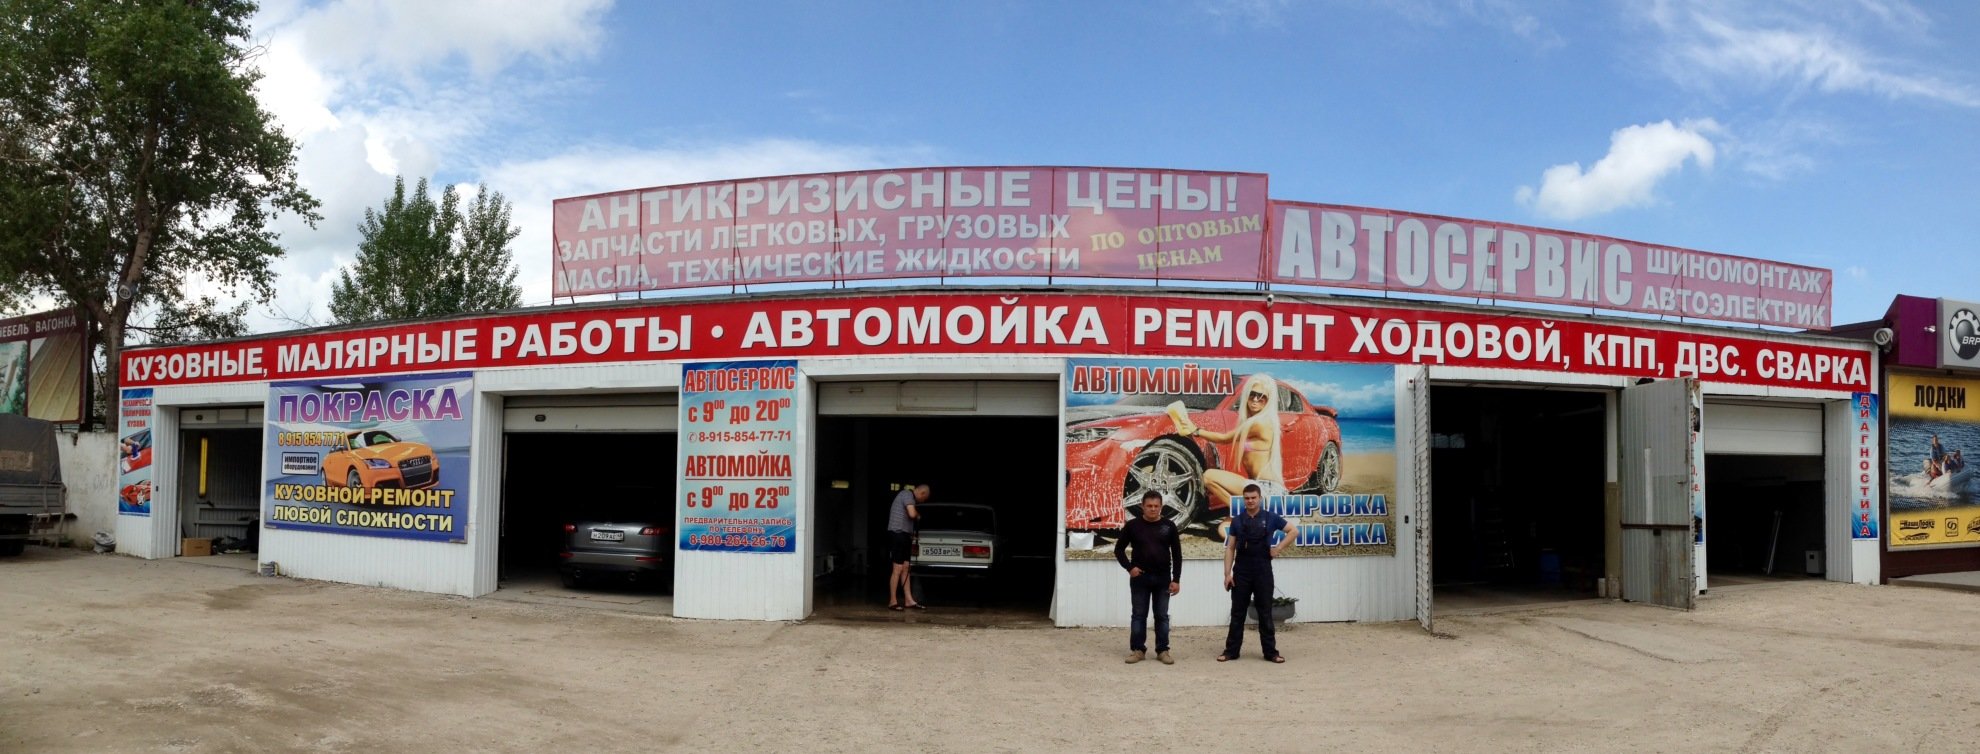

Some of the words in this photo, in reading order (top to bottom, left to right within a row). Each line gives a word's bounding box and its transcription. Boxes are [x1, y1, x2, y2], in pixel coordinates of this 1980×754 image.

[577, 171, 1031, 233] АНТИКРИЗИСНЫЕ
[1066, 171, 1238, 215] ЦЕНЫ!
[557, 226, 702, 262] ЗАПЧАСТИ
[710, 216, 886, 250] ЛЕГКОВЫХ,
[898, 213, 1070, 241] ГРУЗОВЫХ
[1090, 229, 1125, 253] ПО
[1137, 213, 1262, 246] ОПТОВЫМ
[557, 263, 659, 292] МАСЛА,
[667, 249, 885, 284] ТЕХНИЧЕСКИЕ
[895, 246, 1080, 276] ЖИДКОСТИ
[1136, 245, 1224, 271] ЦЕНАМ
[1277, 208, 1633, 307] АВТОСЕРВИС
[1646, 247, 1824, 294] ШИНОМОНТАЖ
[1641, 285, 1826, 328] АВТОЭЛЕКТРИК
[0, 323, 29, 338] ЕБЕЛЬ
[35, 315, 77, 333] ВАГОНКА
[1962, 335, 1980, 346] BRP
[126, 347, 268, 382] КУЗОВНЫЕ,
[277, 327, 478, 373] МАЛЯРНЫЕ
[491, 314, 692, 360] РАБОТЫ
[740, 296, 1110, 349] АВТОМОЙКА
[1133, 306, 1336, 352] РЕМОНТ
[1348, 316, 1571, 371] ХОДОВОЙ,
[1583, 332, 1665, 377] КПП,
[1674, 341, 1747, 379] ДВС.
[1756, 349, 1868, 386] СВАРКА
[684, 366, 795, 393] АВТОСЕРВИС
[1071, 363, 1235, 396] АВТОМОЙКА
[278, 386, 464, 424] ПОКРАСКА
[1913, 384, 1966, 412] ЛОДКИ
[729, 405, 750, 424] до
[698, 430, 792, 443] 8-915-854-77-71
[684, 449, 792, 477] АВТОМОЙКА
[1859, 394, 1871, 538] ДИАГНОСТИКА
[274, 483, 365, 504] КУЗОВНОЙ
[370, 488, 455, 508] РЕМОНТ
[728, 492, 749, 511] до
[1229, 493, 1388, 519] ПЛИРОВКА
[273, 504, 332, 524] ЛЮБОЙ
[335, 509, 453, 532] СЛОЖНОСТИ
[684, 517, 759, 526] ПРЕДВАРИТЕЛЬНАЯ
[761, 518, 792, 526] ЗАПИСЬ
[689, 534, 786, 548] 8-980-264-26-76
